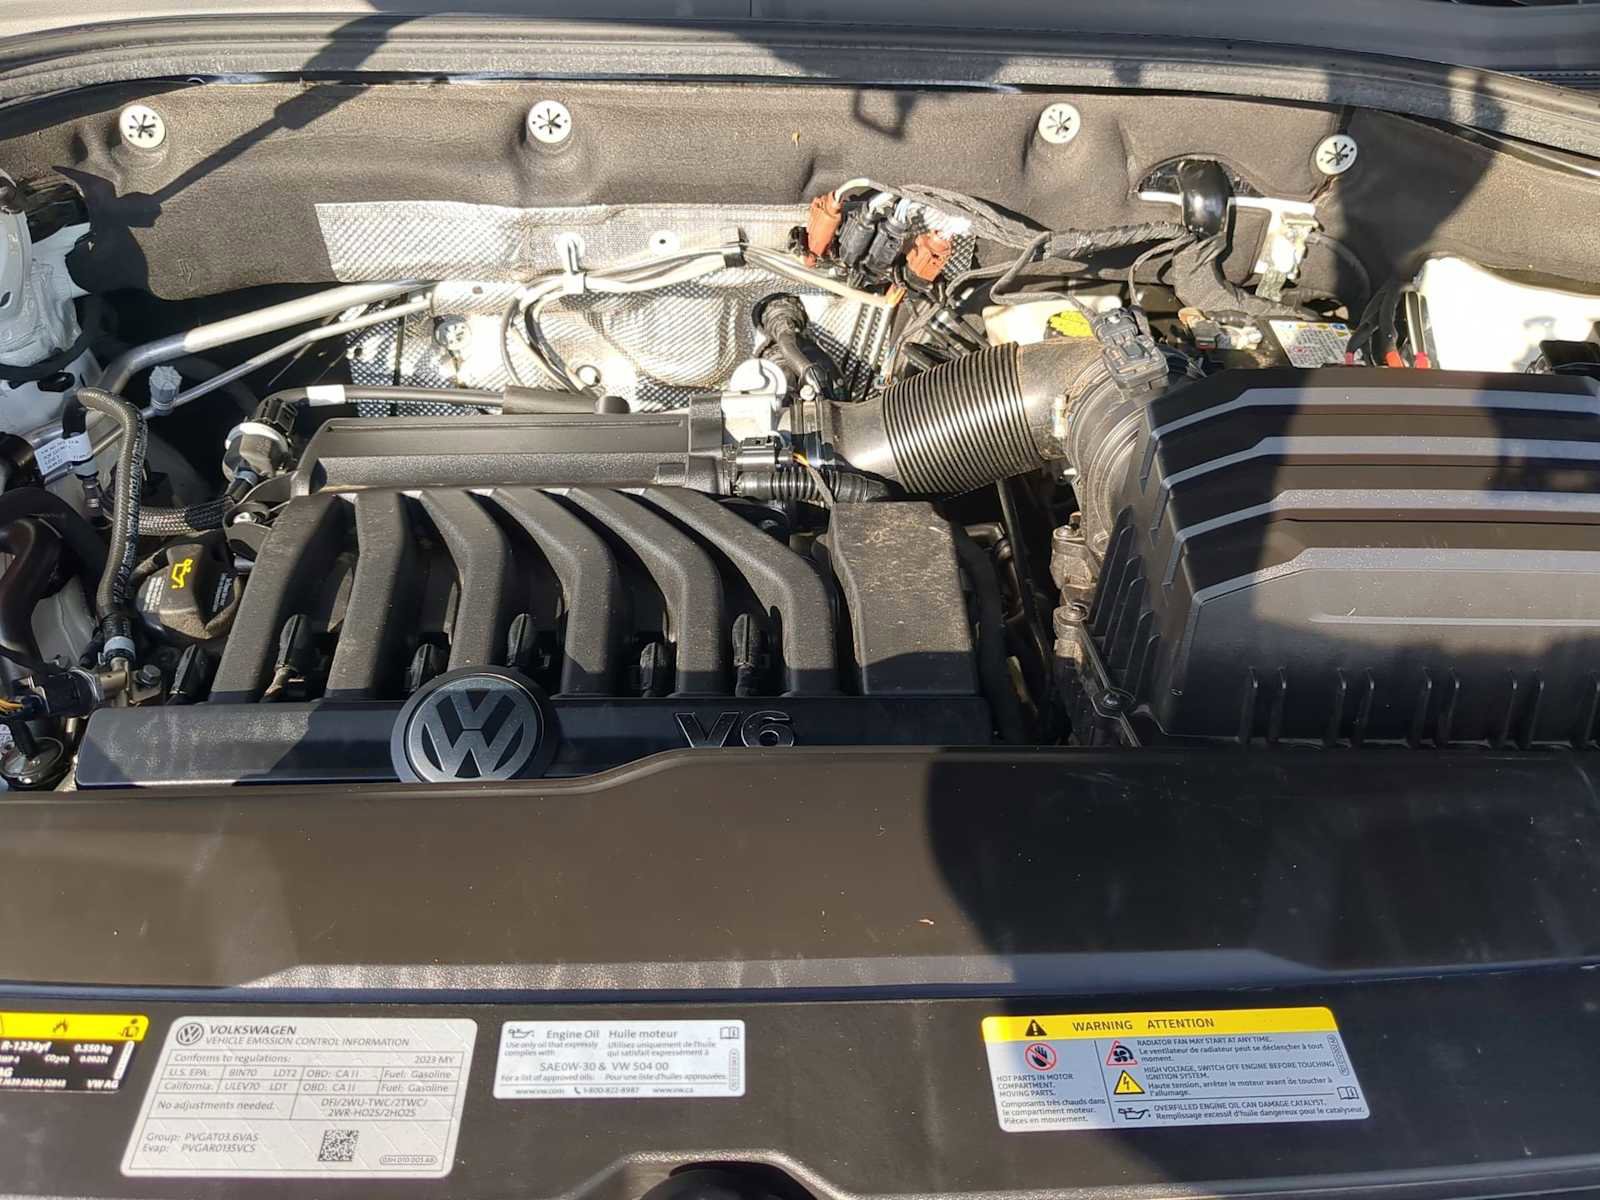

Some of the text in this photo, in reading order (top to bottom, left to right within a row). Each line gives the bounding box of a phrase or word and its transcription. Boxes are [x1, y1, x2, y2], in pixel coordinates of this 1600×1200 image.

[673, 710, 799, 747] V6
[1072, 1018, 1215, 1032] WARNING ATTENTION
[209, 1025, 297, 1035] VOLKSWAGEN
[608, 1030, 637, 1038] Huile
[546, 1030, 600, 1040] Engine Oil
[205, 1036, 410, 1046] VEHICLE EMISSION CONTROL INFORMATION
[564, 1041, 599, 1049] expressly
[637, 1041, 680, 1049] uniquement
[1, 1040, 52, 1053] R-1234yf
[100, 1044, 114, 1055] kg
[1234, 1045, 1251, 1053] peut
[1307, 1042, 1324, 1050] tout
[620, 1049, 650, 1057] satisfait
[174, 1054, 219, 1062] Conforms
[234, 1054, 291, 1064] regulations:
[539, 1062, 669, 1072] SAE0W-30 & VW 504 00
[1297, 1060, 1335, 1068] TOUCHING
[189, 1069, 210, 1077] EPA:
[229, 1069, 258, 1077] BIN70
[272, 1069, 297, 1077] LDT2
[306, 1070, 332, 1078] OBD:
[335, 1070, 348, 1078] CA
[383, 1070, 452, 1079] Fuel: Gasoline
[638, 1073, 654, 1081] liste
[655, 1073, 682, 1081] d'huiles
[542, 1074, 580, 1082] approved
[1229, 1079, 1236, 1087] le
[1237, 1079, 1263, 1087] moteur
[1297, 1077, 1326, 1085] toucher
[104, 1080, 119, 1089] AG
[224, 1082, 260, 1090] ULEV70
[303, 1083, 328, 1091] OBD:
[332, 1083, 345, 1091] CA
[381, 1084, 449, 1092] Fuel: Gasoline
[158, 1101, 275, 1112] No adjustments needed.
[1001, 1099, 1046, 1108] Composants
[1062, 1098, 1087, 1106] chauds
[1154, 1103, 1199, 1111] OVERFILLED
[1200, 1102, 1228, 1110] ENGINE
[1228, 1101, 1240, 1109] OIL
[1258, 1100, 1289, 1108] DAMAGE
[1290, 1099, 1327, 1107] CATALYST.
[1002, 1108, 1010, 1116] le
[1011, 1107, 1065, 1117] compartiment
[1155, 1111, 1203, 1120] Remplissage
[1204, 1110, 1232, 1118] excessif
[1260, 1109, 1298, 1118] dangereux
[1299, 1109, 1316, 1117] pour
[1004, 1117, 1029, 1125] Pièces
[1040, 1115, 1089, 1124] mouvement.
[146, 1133, 181, 1143] Group:
[143, 1144, 169, 1153] Evap:
